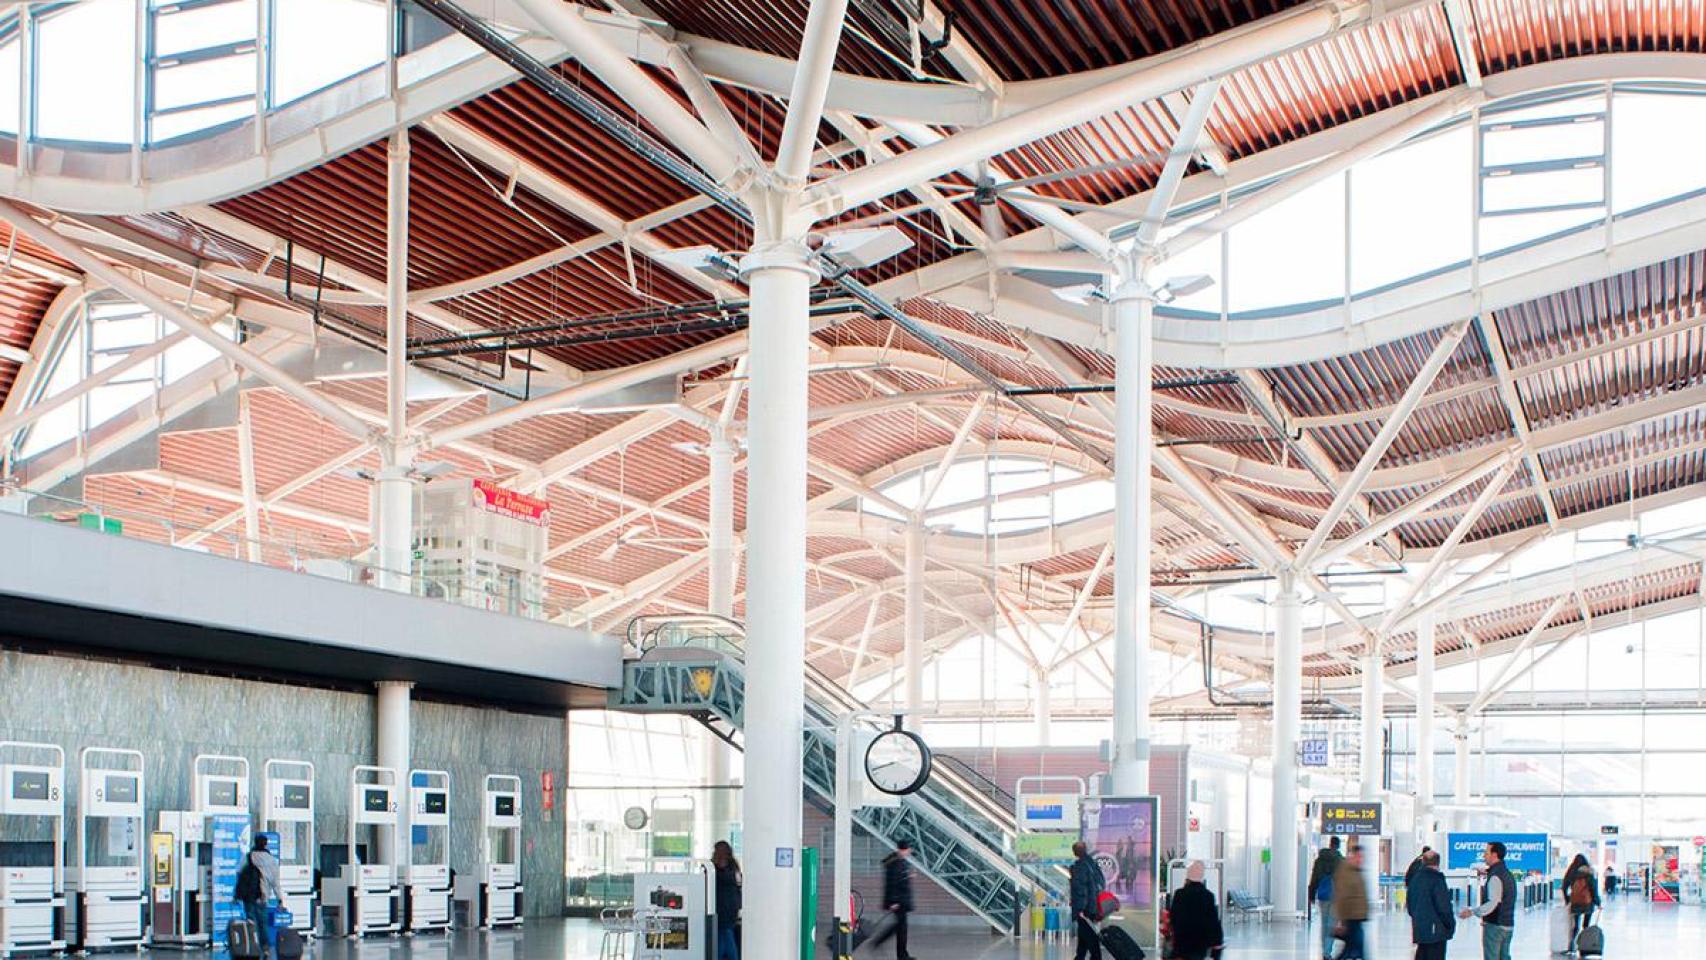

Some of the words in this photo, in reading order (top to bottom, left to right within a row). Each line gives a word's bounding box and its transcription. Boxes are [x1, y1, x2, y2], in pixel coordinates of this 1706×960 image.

[51, 787, 59, 801] 8
[96, 788, 103, 802] 9
[239, 795, 248, 808] 10
[388, 801, 398, 813] 12
